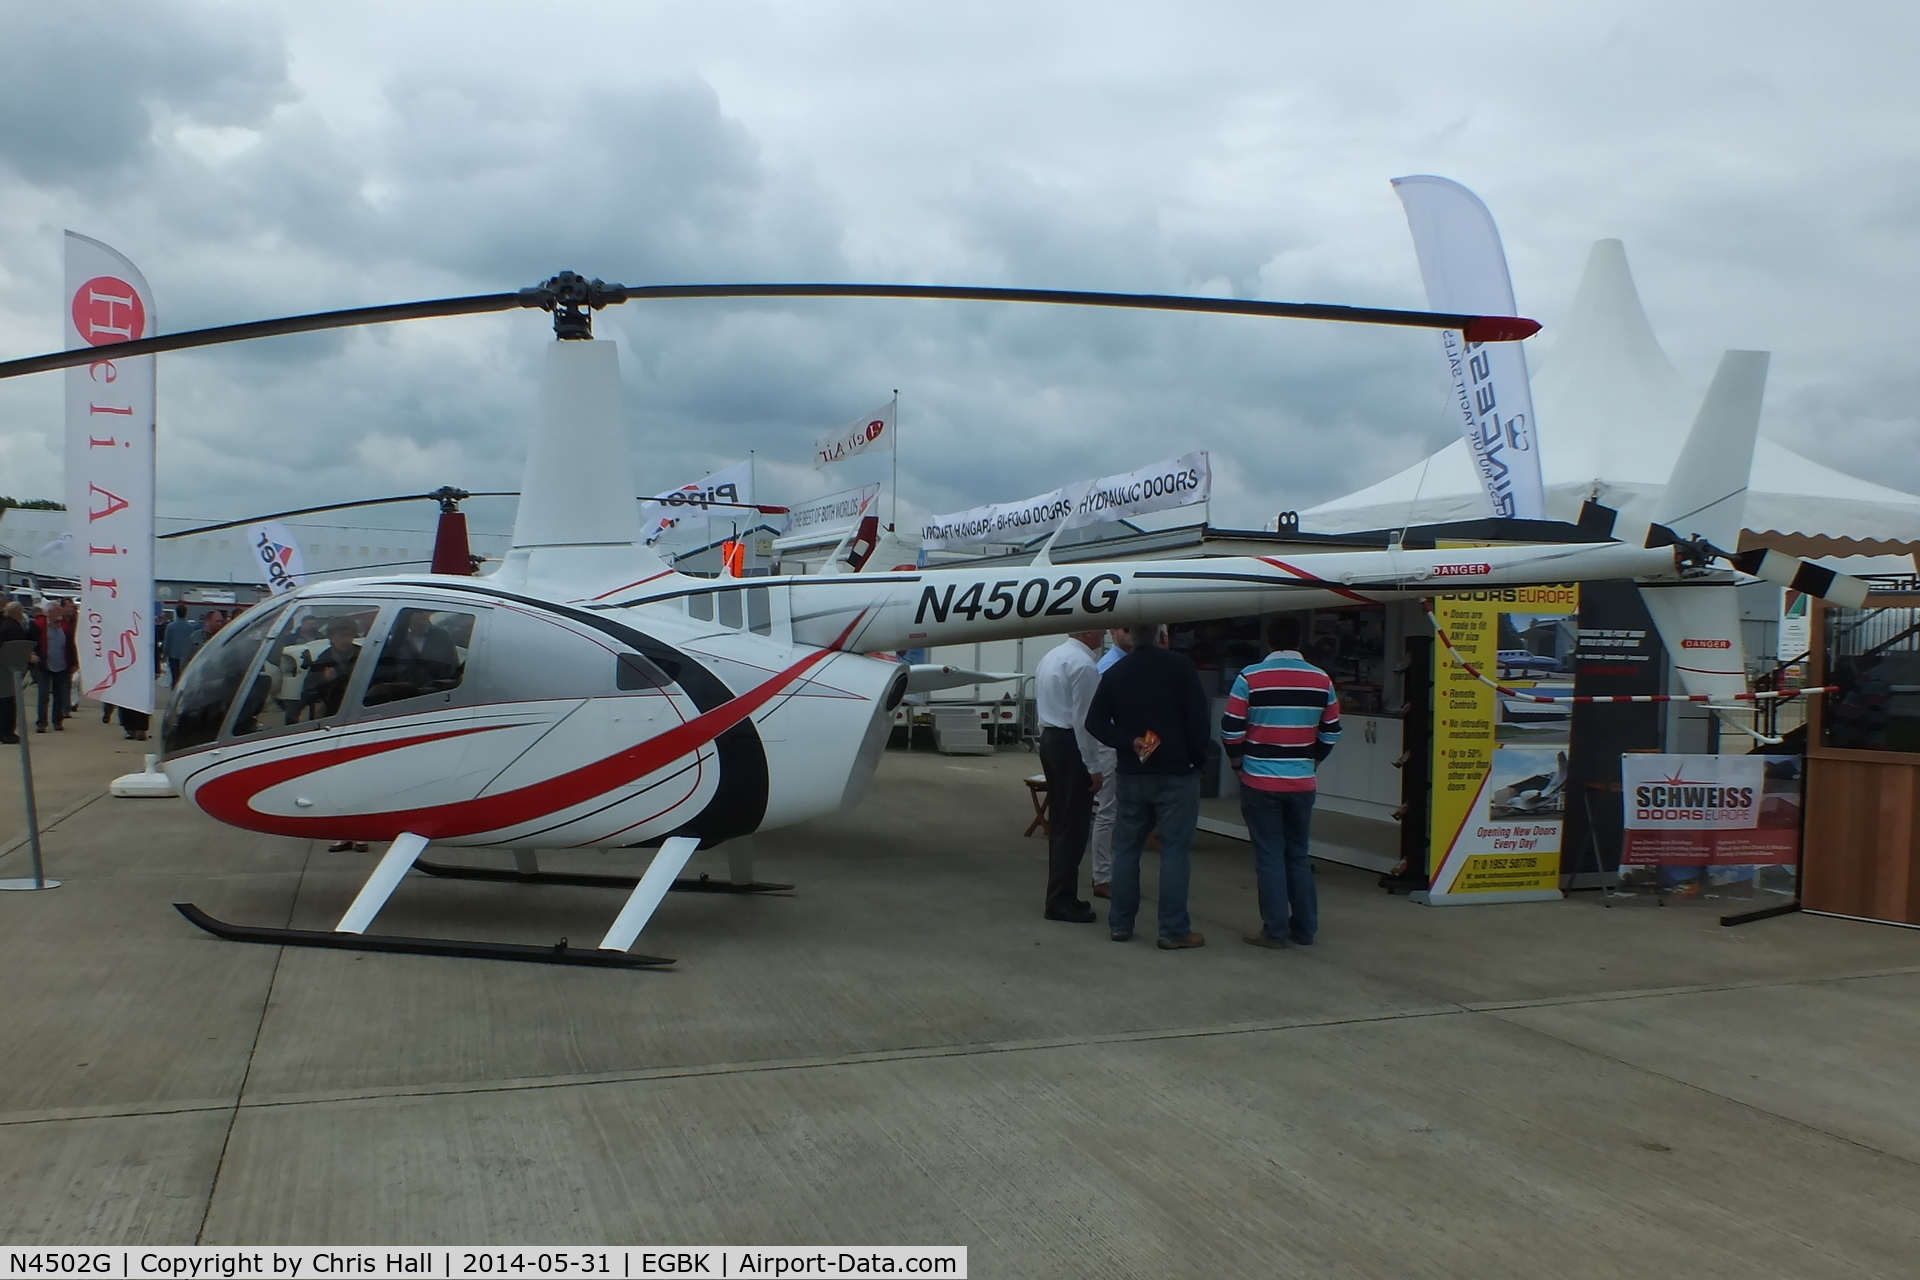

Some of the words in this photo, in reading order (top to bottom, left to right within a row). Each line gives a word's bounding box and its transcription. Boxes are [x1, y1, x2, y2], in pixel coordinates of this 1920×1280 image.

[1143, 468, 1199, 497] DOORS
[1432, 564, 1486, 576] DANGER
[914, 573, 1122, 624] N4502G
[1450, 609, 1470, 619] Doors
[1465, 631, 1480, 641] size
[1685, 640, 1728, 648] DANGER
[1450, 688, 1476, 698] Remote
[1636, 786, 1753, 809] SCHWEISS
[1476, 826, 1511, 839] Opening
[1512, 826, 1532, 836] New
[1532, 825, 1557, 836] Doors
[1493, 838, 1518, 850] Every
[1518, 838, 1538, 850] Day!
